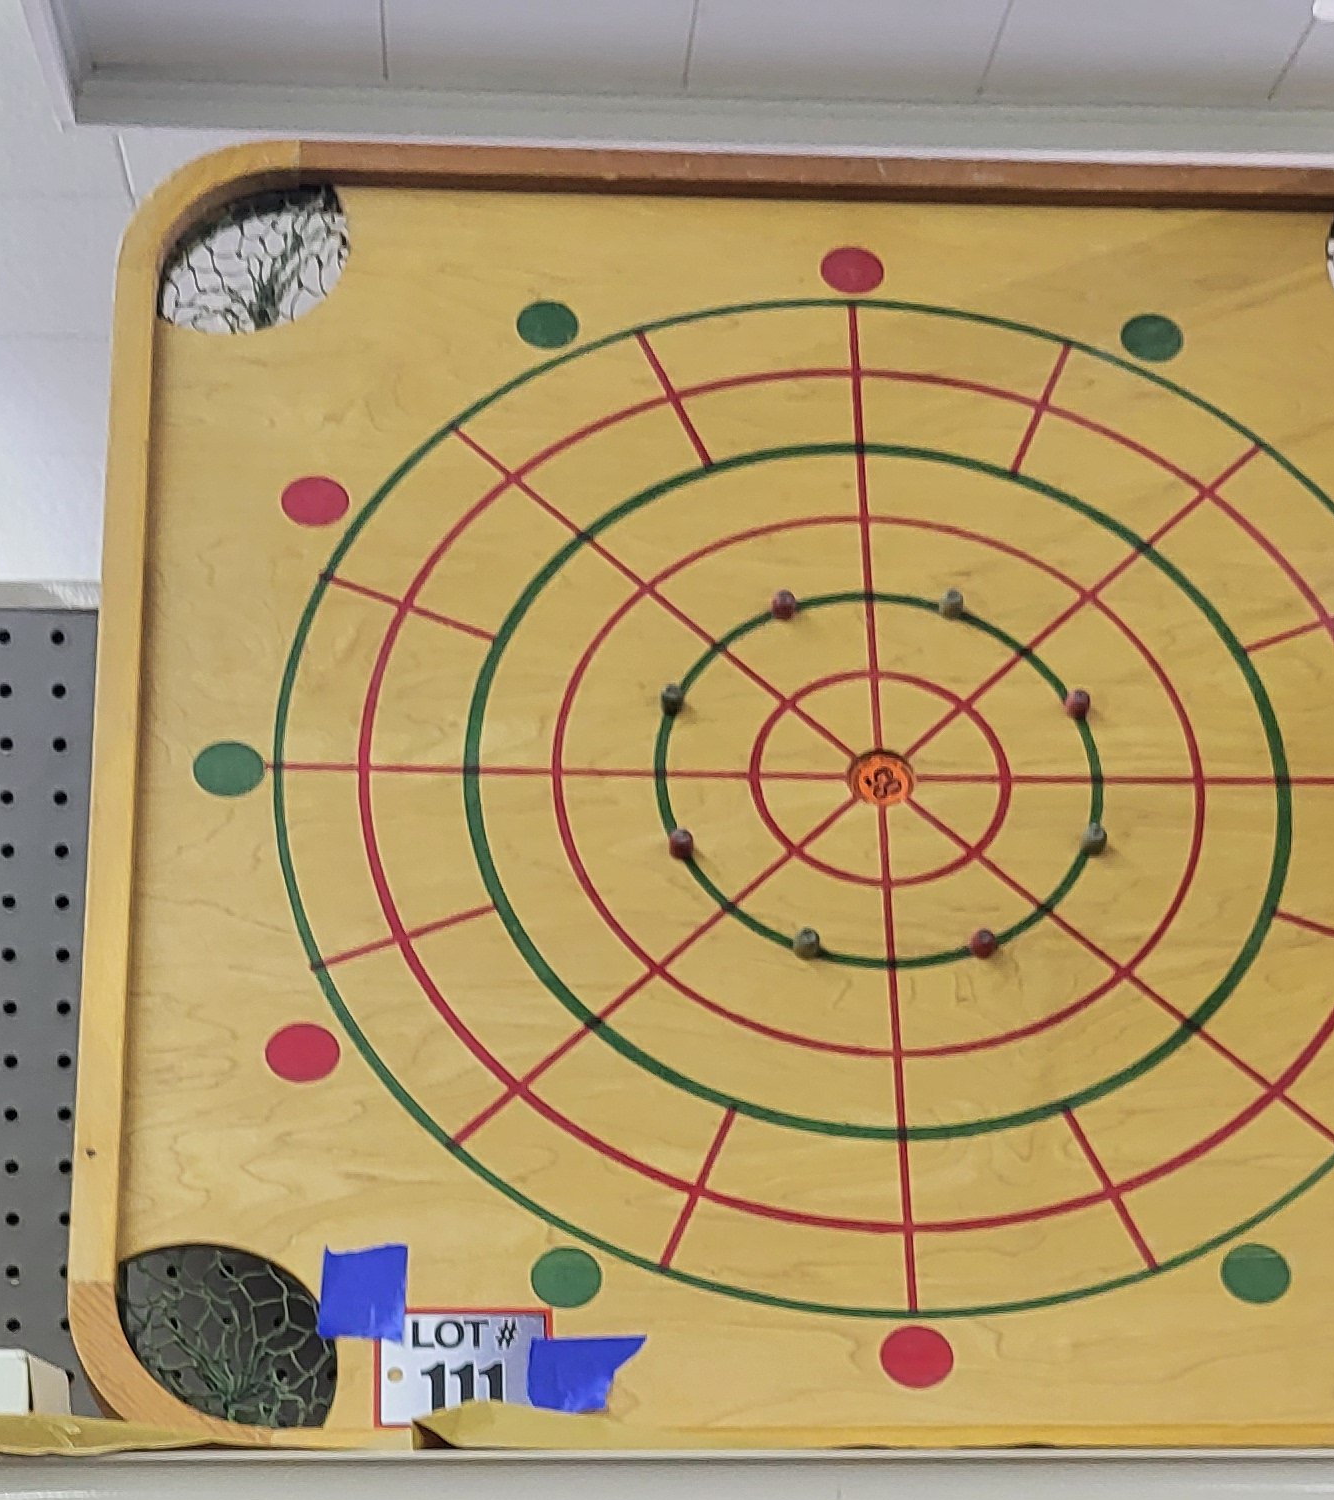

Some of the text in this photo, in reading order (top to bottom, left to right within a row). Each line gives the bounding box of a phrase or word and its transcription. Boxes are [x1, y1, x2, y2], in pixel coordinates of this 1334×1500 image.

[412, 1320, 518, 1349] LOT #
[420, 1360, 505, 1411] 111
